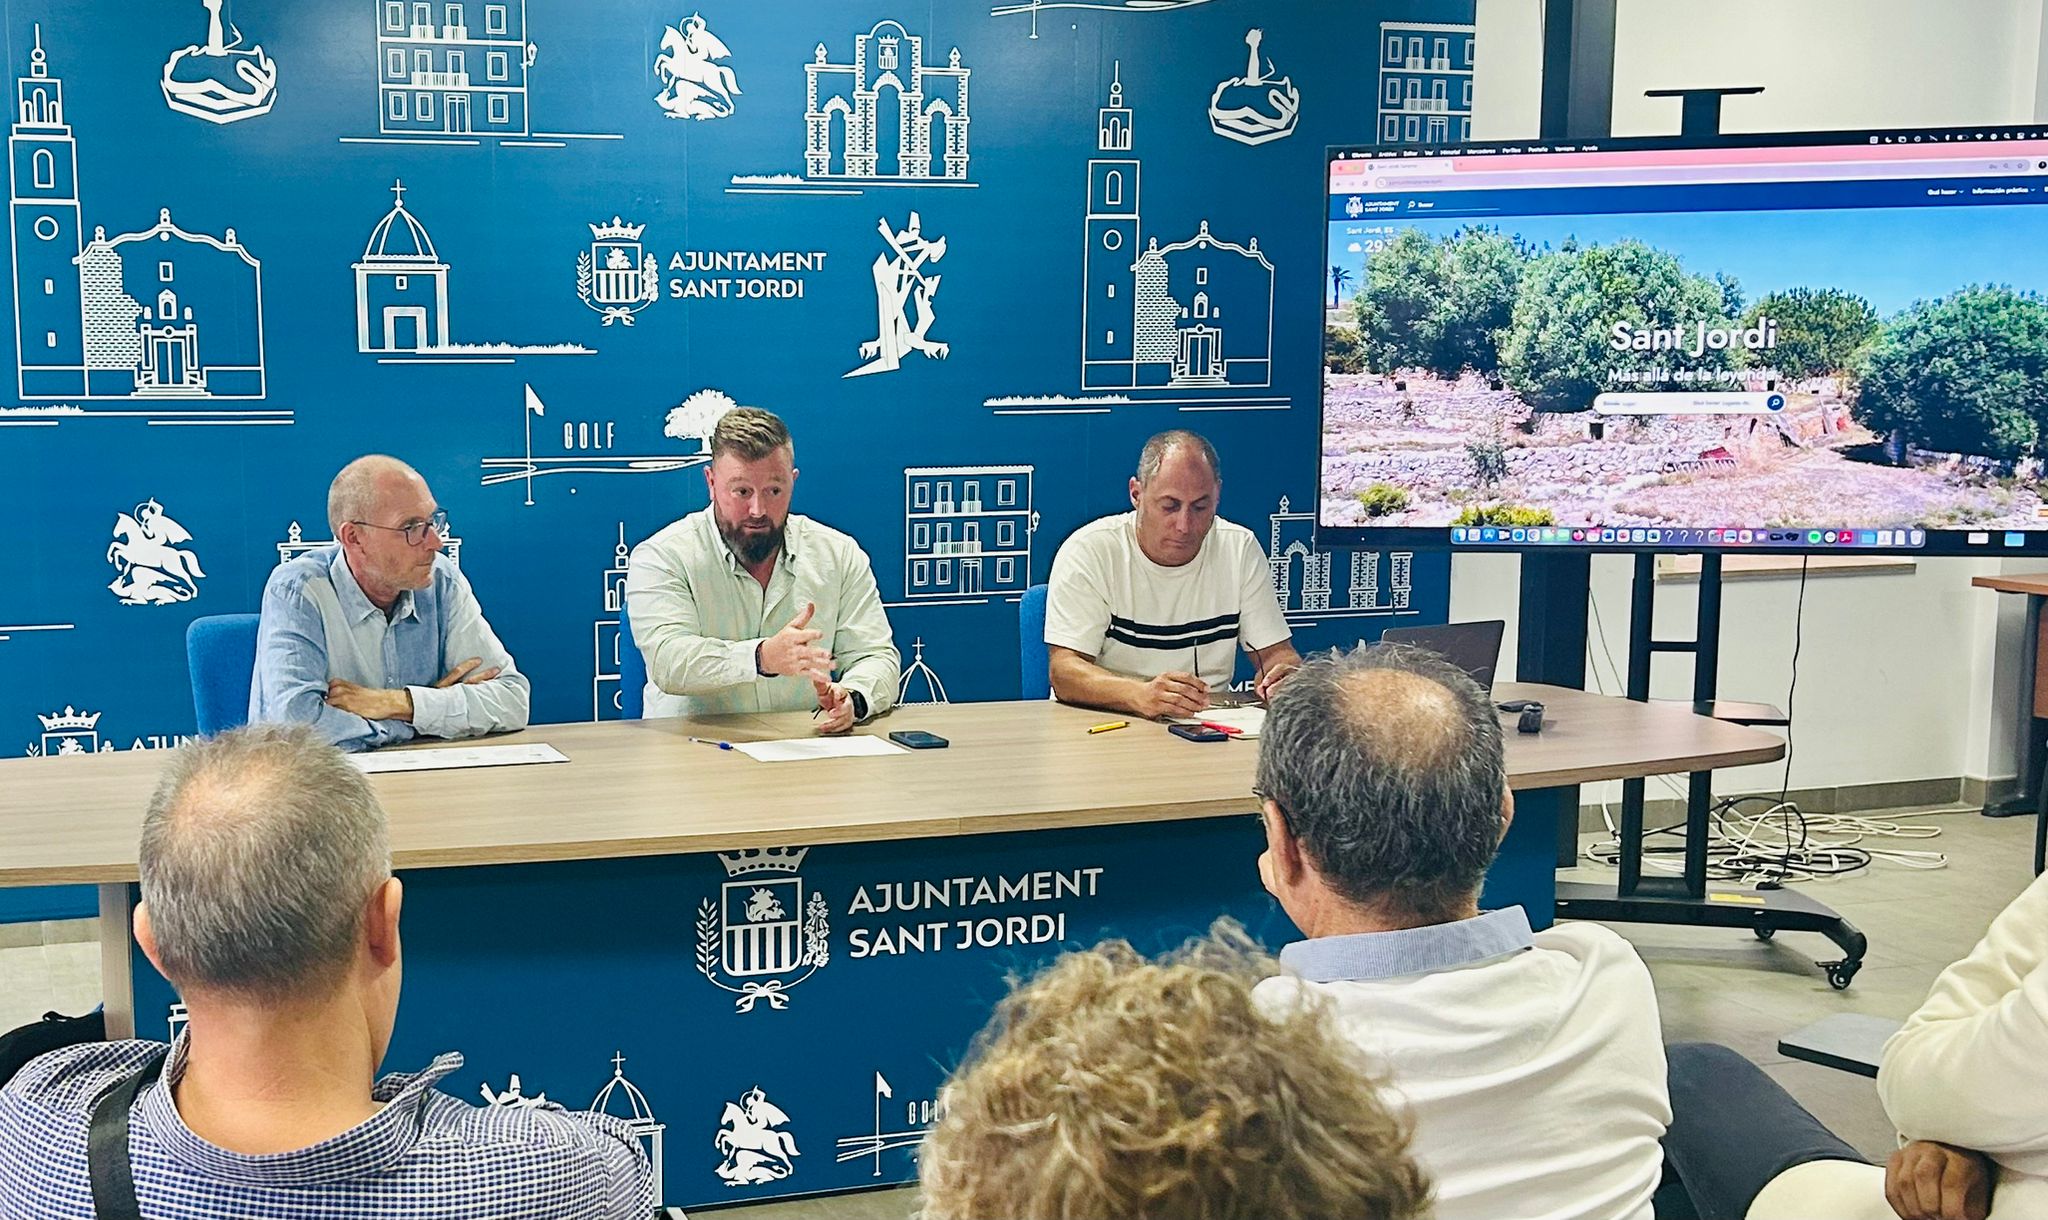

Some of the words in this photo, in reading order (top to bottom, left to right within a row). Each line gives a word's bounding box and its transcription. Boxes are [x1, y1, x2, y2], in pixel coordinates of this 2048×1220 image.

[668, 251, 827, 272] AJUNTAMENT
[669, 278, 732, 299] SANT
[735, 278, 804, 299] JORDI
[1610, 320, 1684, 351] Sant
[1688, 316, 1777, 358] Jordi
[1608, 368, 1639, 383] Más
[1643, 366, 1670, 382] allá
[1673, 367, 1695, 382] de
[1698, 366, 1712, 381] la
[563, 421, 615, 450] GOLF
[847, 867, 1104, 916] AJUNTAMENT
[849, 922, 949, 958] SANT
[956, 912, 1067, 949] JORDI
[908, 1099, 940, 1125] GOL
